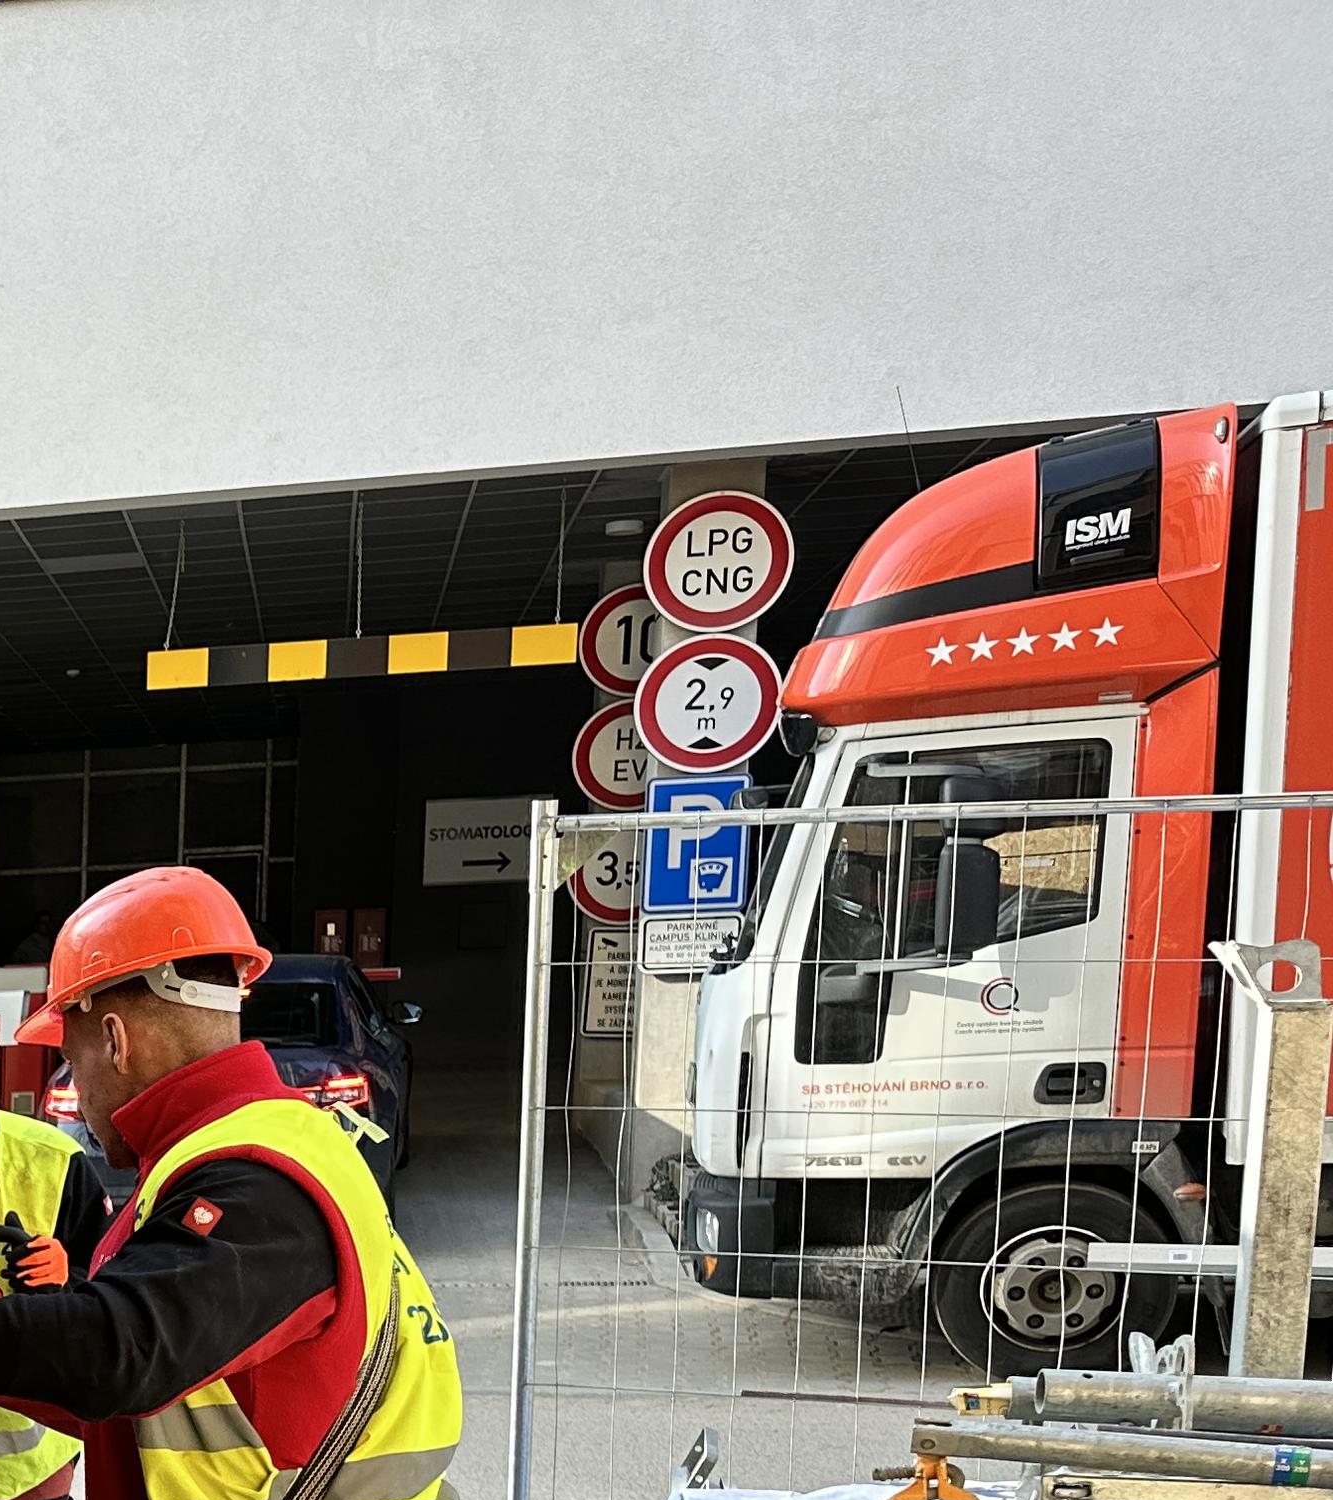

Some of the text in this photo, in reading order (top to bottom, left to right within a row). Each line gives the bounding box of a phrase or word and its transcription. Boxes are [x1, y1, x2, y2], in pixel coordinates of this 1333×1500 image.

[686, 526, 753, 558] LPG
[1064, 507, 1132, 546] ISM
[682, 565, 754, 597] CNG
[684, 678, 735, 713] 2,9
[697, 716, 716, 730] m
[667, 793, 726, 869] P
[649, 932, 690, 943] CAMPUS
[801, 1084, 820, 1095] SB
[824, 1079, 906, 1095] STĚHOVÁNÍ
[909, 1080, 951, 1092] BRNO
